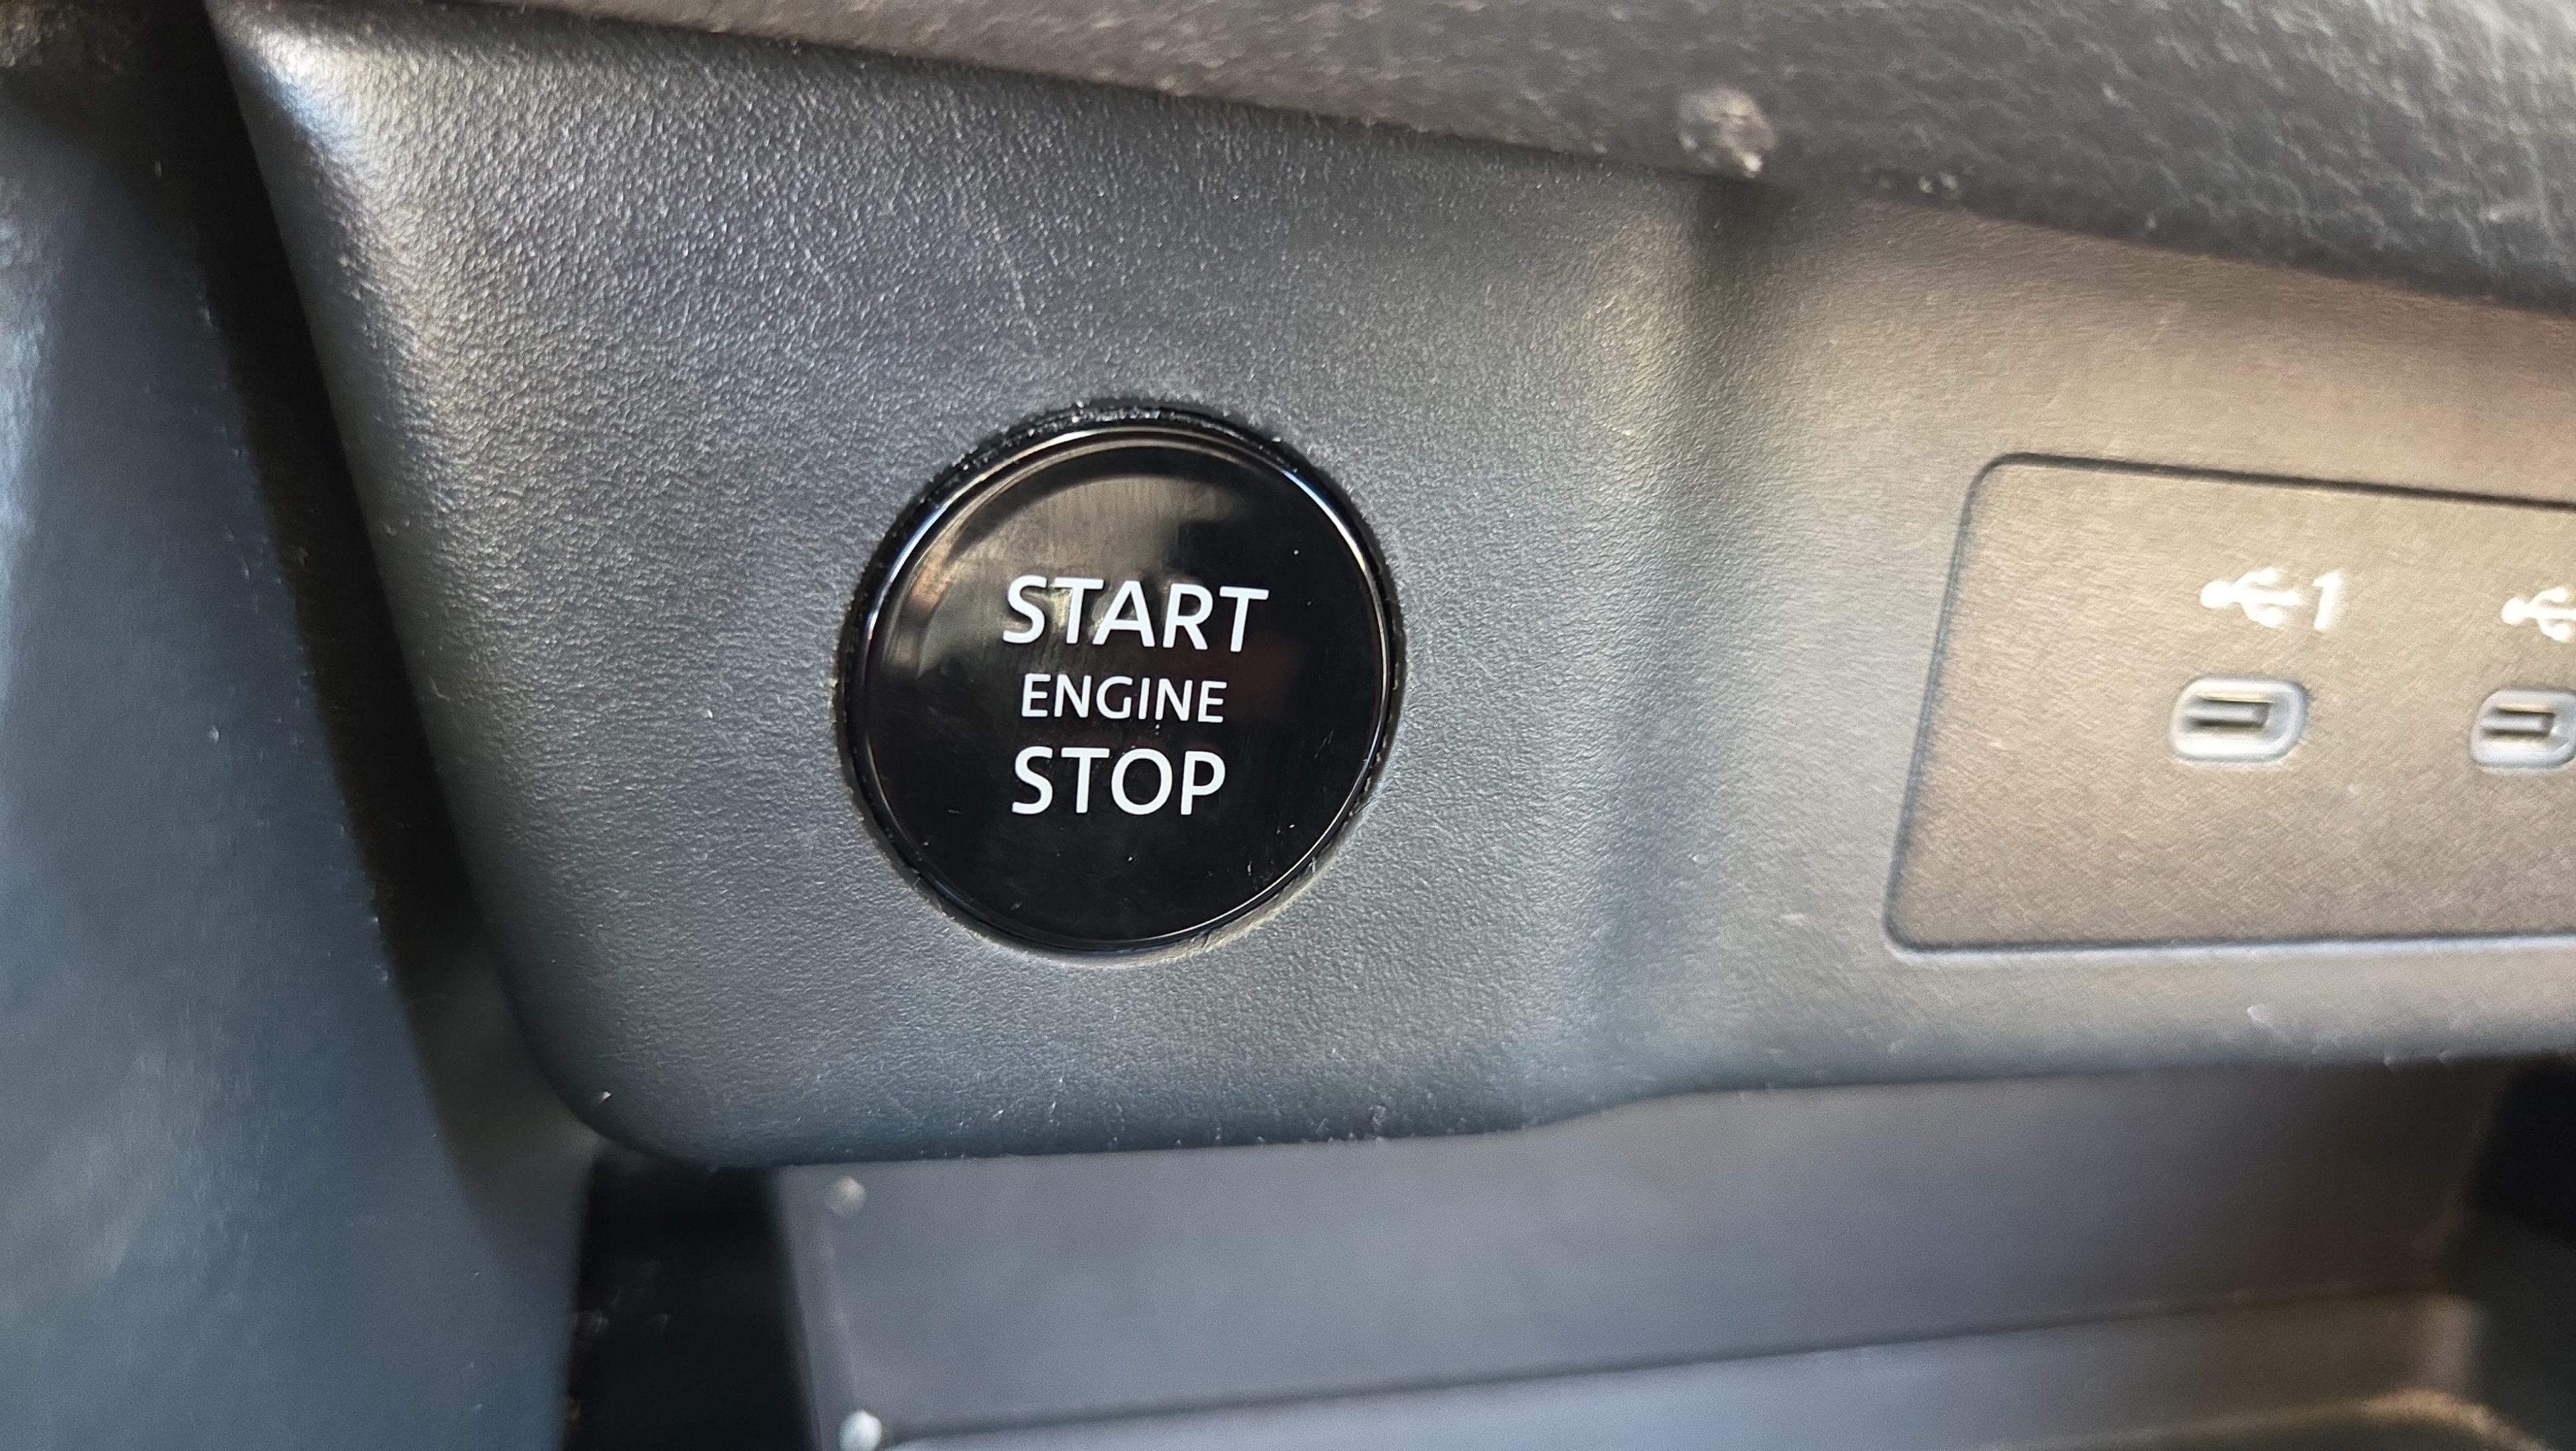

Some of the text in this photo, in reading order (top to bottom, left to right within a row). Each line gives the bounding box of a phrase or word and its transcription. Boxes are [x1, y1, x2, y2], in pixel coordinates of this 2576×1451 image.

[1002, 574, 1269, 652] START
[2312, 570, 2346, 633] 1
[1021, 673, 1228, 723] ENGINE
[1011, 746, 1226, 815] STOP
